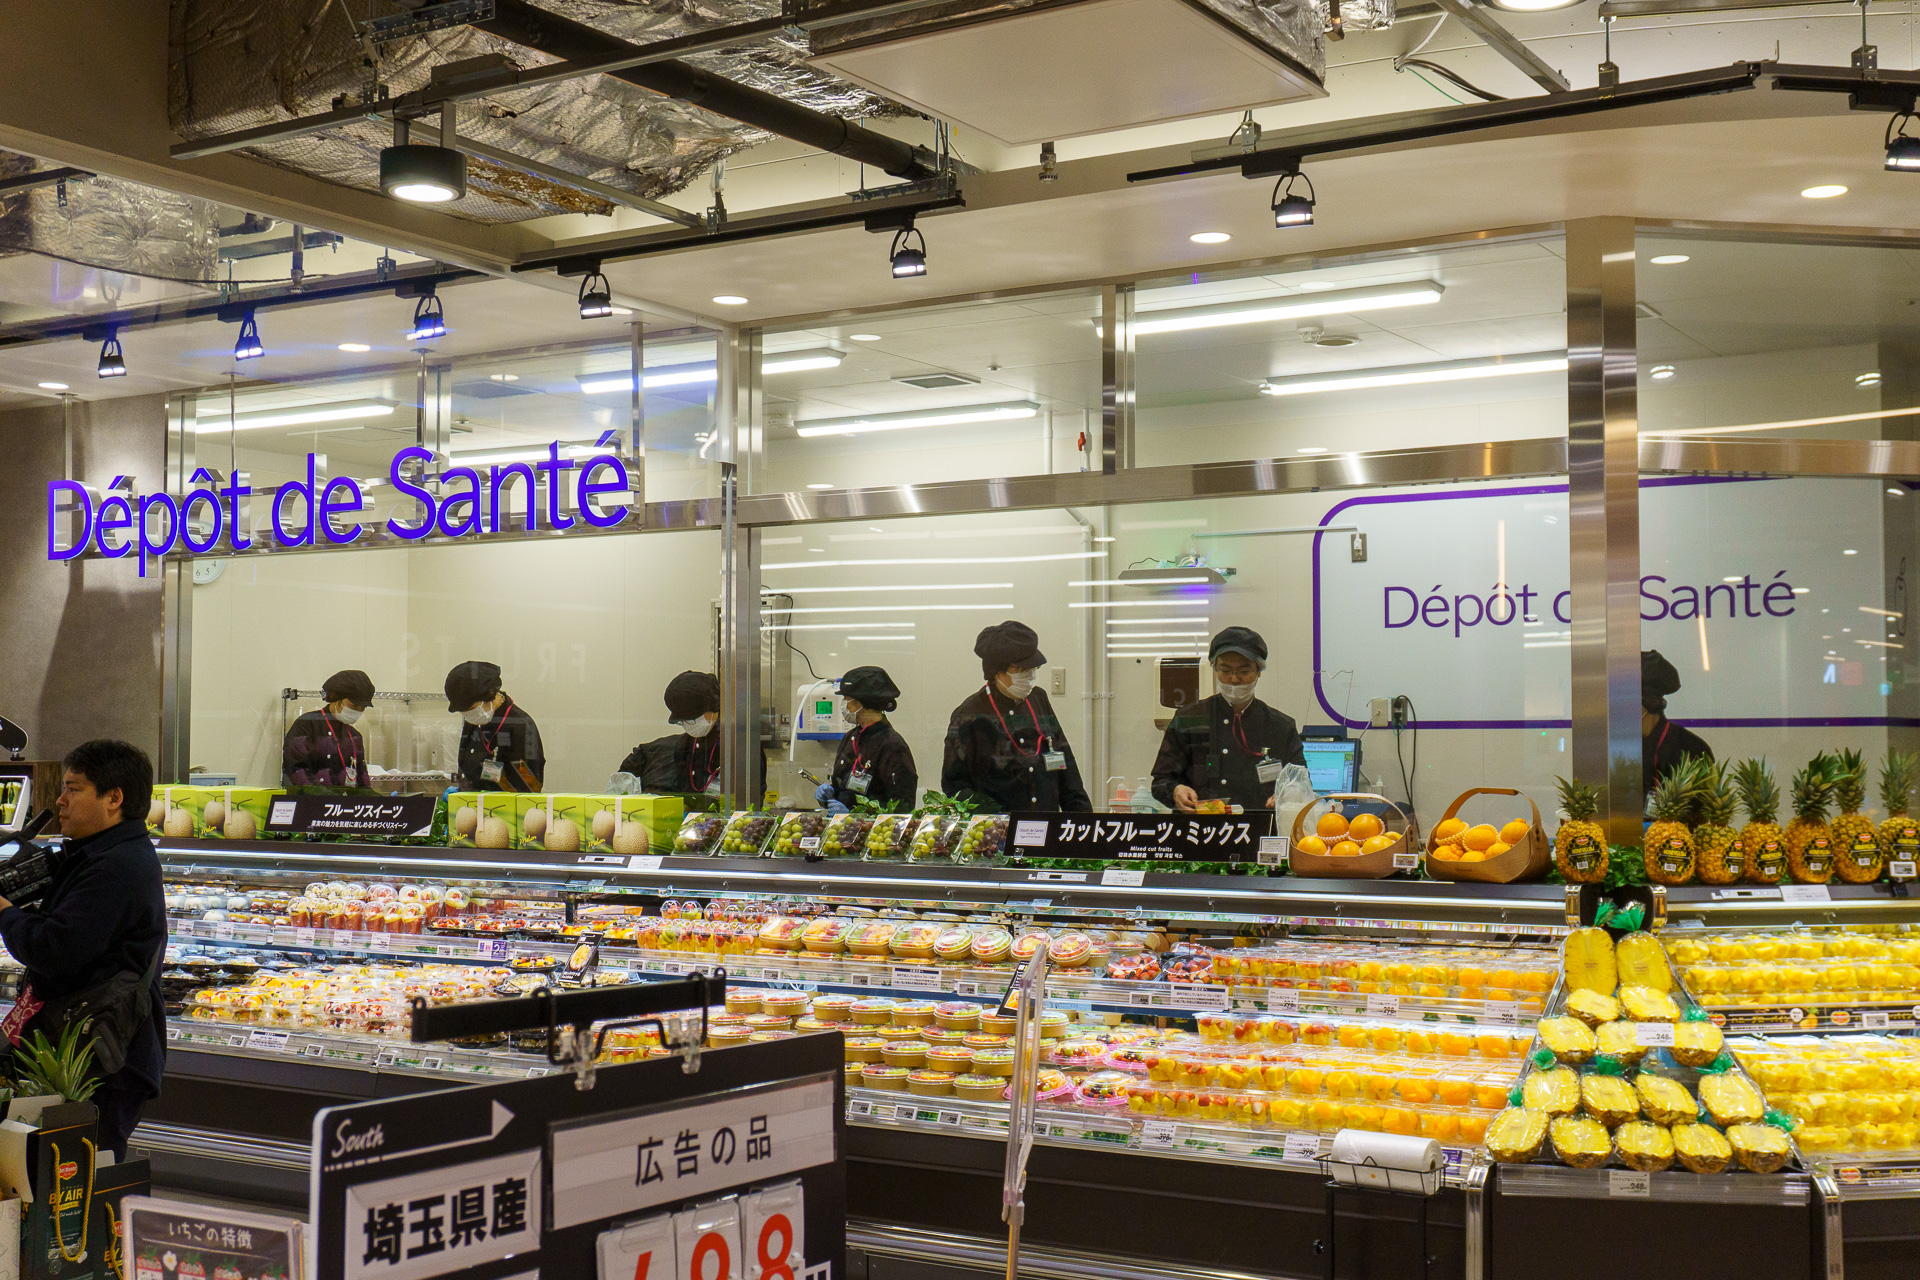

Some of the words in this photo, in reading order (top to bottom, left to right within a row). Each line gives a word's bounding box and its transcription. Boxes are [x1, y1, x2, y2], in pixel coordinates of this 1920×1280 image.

[48, 468, 252, 577] Dépôt
[272, 453, 364, 547] de
[388, 430, 630, 540] Santé
[195, 569, 201, 577] 6
[205, 567, 210, 576] 5
[1384, 583, 1538, 637] Dépôt
[1640, 570, 1796, 621] Santé
[323, 803, 404, 819] フルーツスイーツ
[451, 833, 468, 842] Melon
[520, 835, 537, 845] Melon
[1059, 819, 1251, 846] カットフルーツ・ミックス
[588, 838, 605, 848] Melon
[331, 1117, 385, 1158] South
[634, 1114, 771, 1187] 広告の品
[1630, 1182, 1645, 1190] 248
[65, 1187, 84, 1202] AIR
[363, 1177, 527, 1264] 埼玉県産
[168, 1221, 253, 1250] いちごの特徴
